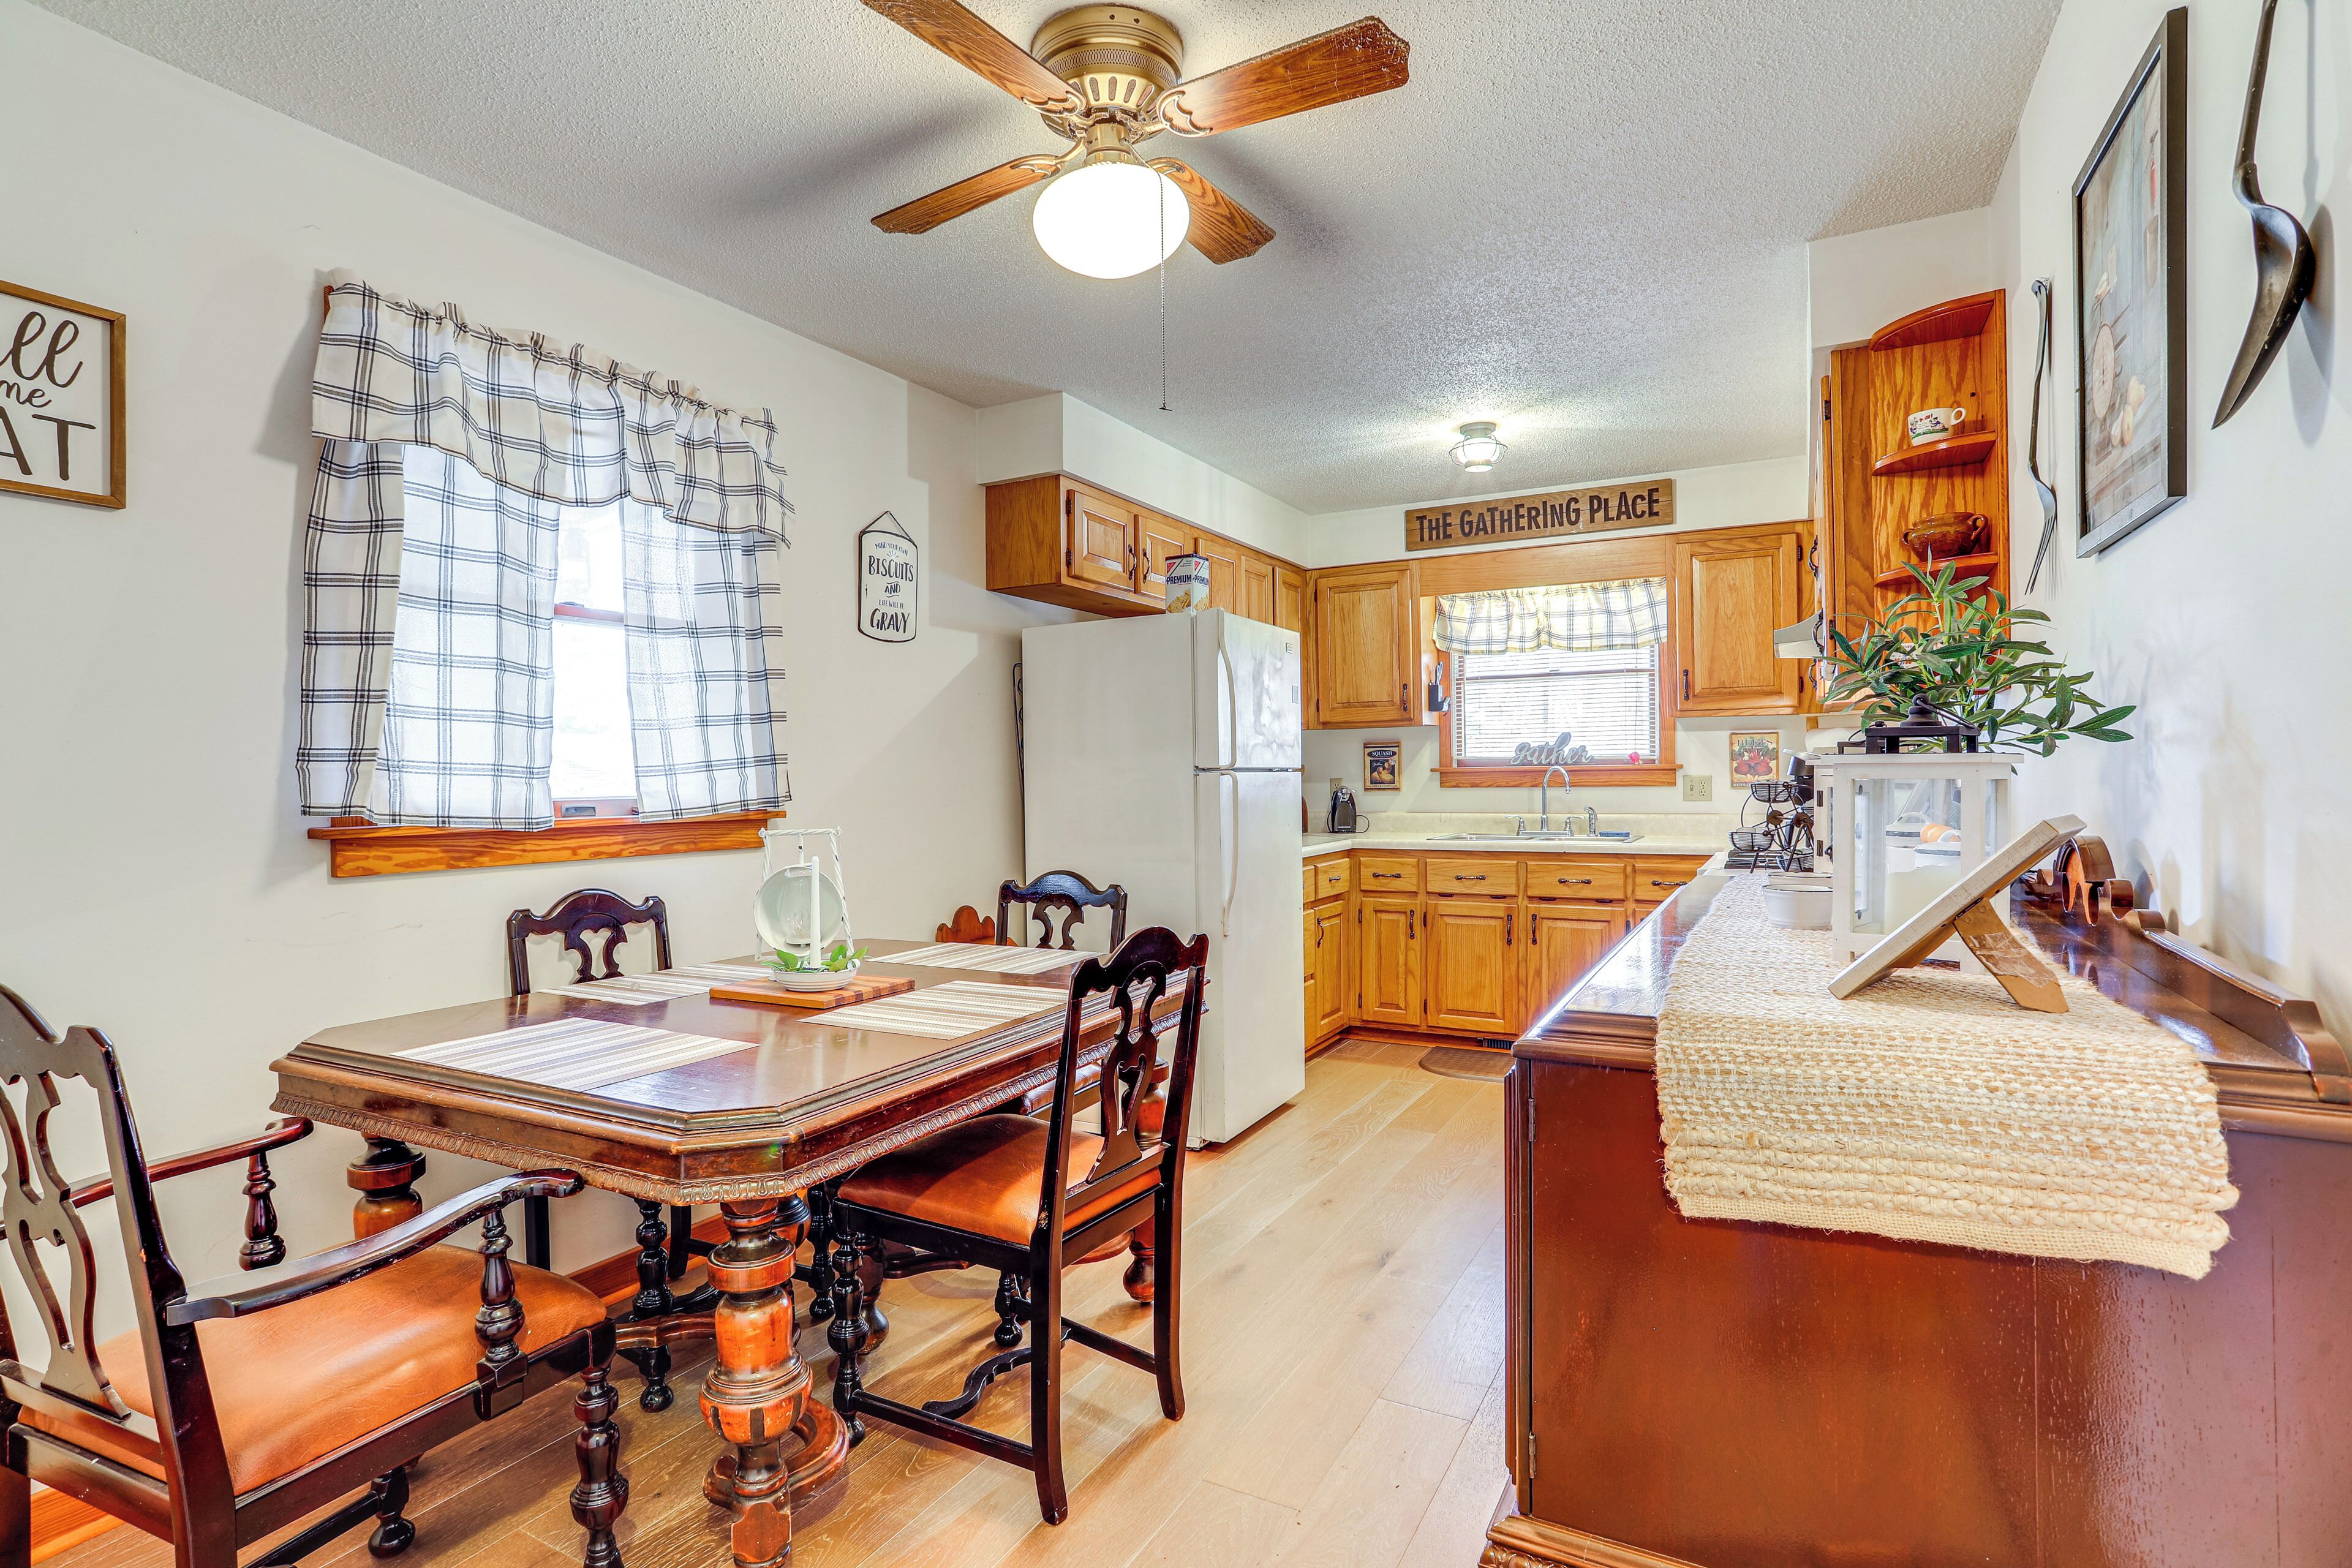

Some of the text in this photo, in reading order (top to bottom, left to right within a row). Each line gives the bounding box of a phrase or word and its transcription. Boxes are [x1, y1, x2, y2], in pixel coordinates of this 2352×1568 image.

[1415, 487, 1660, 542] THE GATHERING PLACE
[899, 546, 908, 556] OWN
[868, 555, 914, 582] BISCUITS
[884, 583, 901, 595] AND
[1166, 575, 1192, 585] PREMIUM
[889, 600, 899, 609] WILL
[870, 608, 910, 634] GRAVY
[1509, 732, 1595, 765] gather
